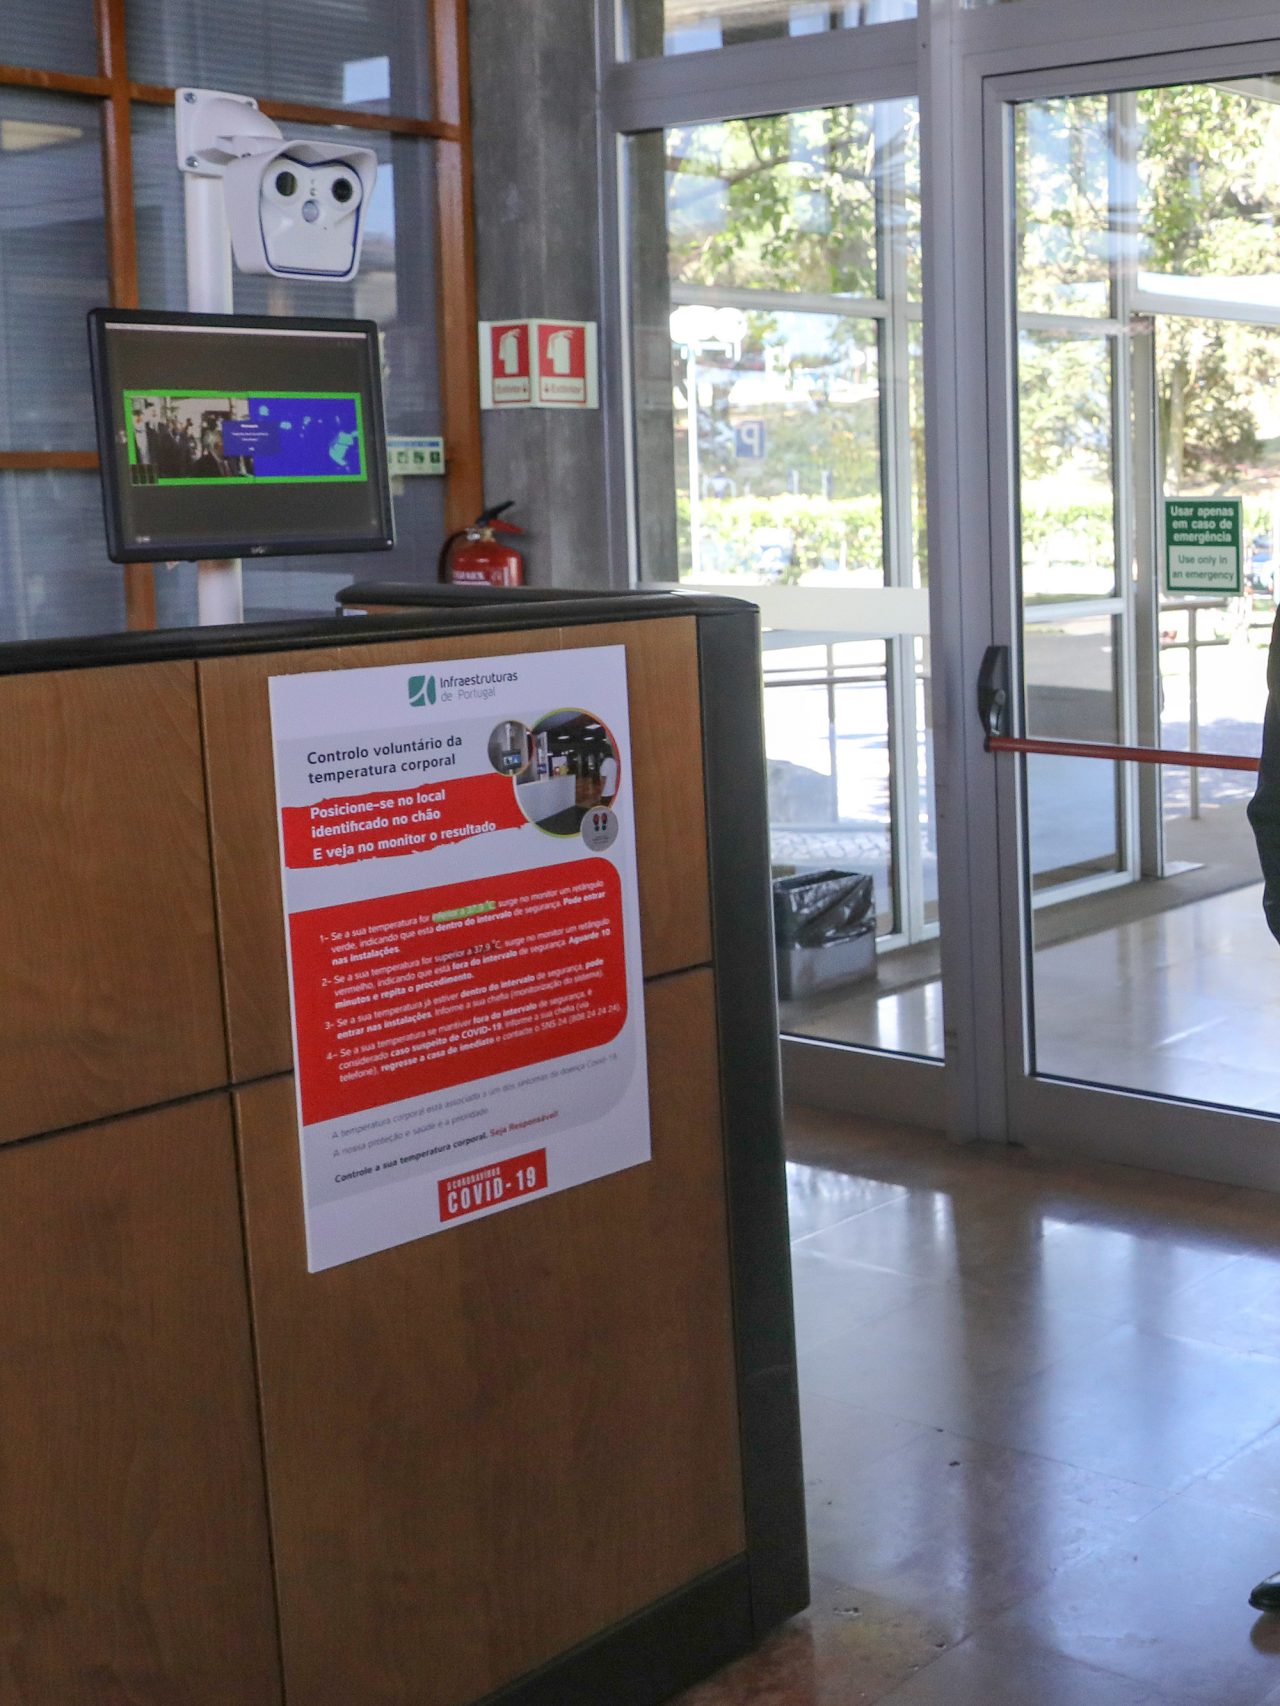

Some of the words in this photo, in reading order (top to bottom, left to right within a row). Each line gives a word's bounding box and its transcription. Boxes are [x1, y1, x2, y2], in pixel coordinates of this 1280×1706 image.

[1170, 505, 1194, 517] Usar
[1197, 507, 1234, 518] apenas
[1172, 520, 1188, 529] em
[1191, 520, 1216, 529] caso
[1219, 518, 1232, 529] de
[1173, 530, 1232, 544] emergência
[1178, 554, 1195, 564] Use
[1197, 555, 1217, 566] only
[1219, 555, 1228, 564] in
[1172, 570, 1183, 579] an
[1185, 571, 1234, 581] emergency
[440, 672, 518, 688] Infraestruturas
[441, 691, 453, 702] de
[458, 686, 495, 700] Portugal
[307, 747, 369, 765] Controlo
[374, 738, 442, 757] voluntário
[446, 736, 462, 747] da
[308, 763, 396, 784] temperatura
[401, 754, 456, 772] corporal
[311, 799, 394, 820] Posicione-se
[398, 796, 413, 807] no
[417, 789, 446, 804] local
[312, 817, 389, 839] identificado
[392, 815, 408, 826] no
[412, 809, 441, 823] chão
[313, 848, 323, 860] E
[327, 844, 354, 858] veja
[358, 842, 374, 853] no
[378, 833, 426, 850] monitor
[441, 821, 496, 839] resultado
[360, 933, 398, 947] indicando
[400, 930, 416, 941] que
[436, 921, 463, 932] dentro
[477, 910, 512, 924] intervalo
[563, 896, 582, 906] Pode
[368, 918, 418, 933] temperatura
[371, 960, 420, 976] temperatura
[434, 950, 465, 963] superior
[482, 950, 517, 964] intervalo
[335, 996, 371, 1009] minutos
[381, 987, 406, 999] repita
[415, 972, 474, 993] procedimento.
[358, 1013, 372, 1023] sua
[373, 1002, 422, 1019] temperatura
[460, 986, 487, 998] dentro
[500, 975, 535, 989] intervalo
[585, 959, 604, 971] pode
[337, 1027, 364, 1040] entrar
[367, 1023, 382, 1033] nas
[377, 1030, 426, 1048] temperatura
[503, 1002, 537, 1017] intervalo
[381, 1057, 417, 1072] regresse
[427, 1050, 445, 1060] casa
[459, 1036, 495, 1052] imediato
[391, 1047, 410, 1057] caso
[412, 1037, 448, 1052] suspeito
[341, 1117, 391, 1137] temperatura
[393, 1107, 424, 1122] corporal
[335, 1166, 372, 1183] Controle
[383, 1159, 398, 1169] sua
[400, 1143, 451, 1164] temperatura
[453, 1131, 488, 1148] corporal.
